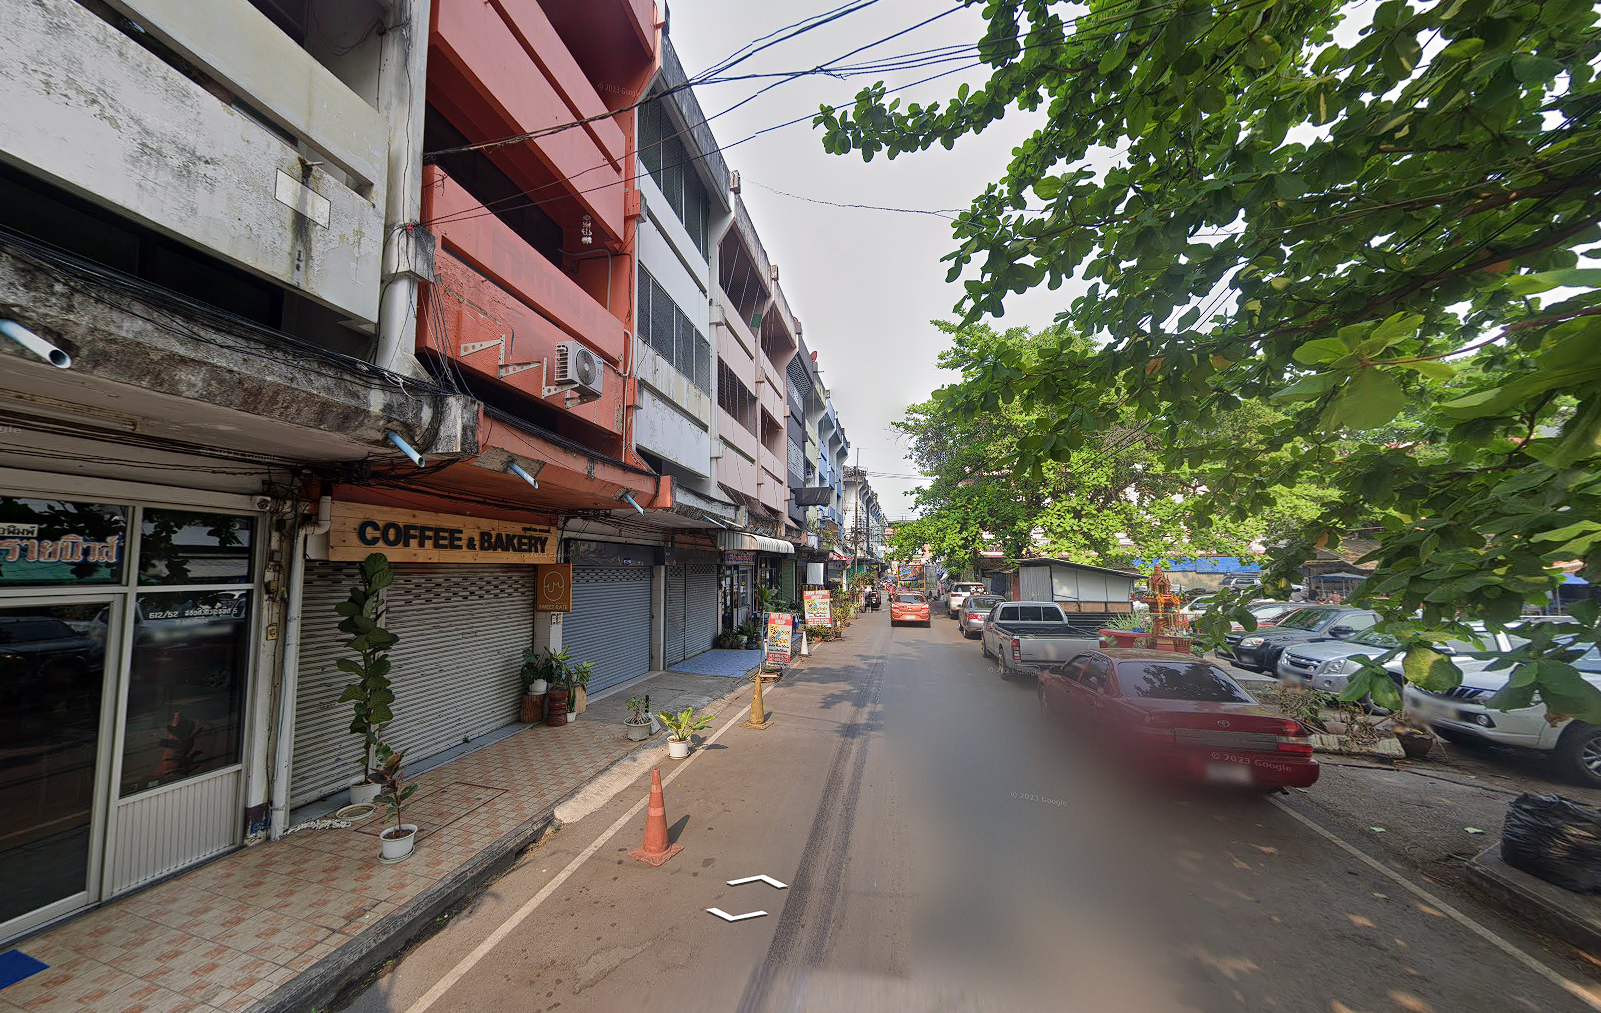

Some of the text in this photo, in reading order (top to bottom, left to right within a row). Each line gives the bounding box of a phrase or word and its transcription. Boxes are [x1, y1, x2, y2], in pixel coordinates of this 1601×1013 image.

[358, 520, 549, 553] COFFEE & BAKERY
